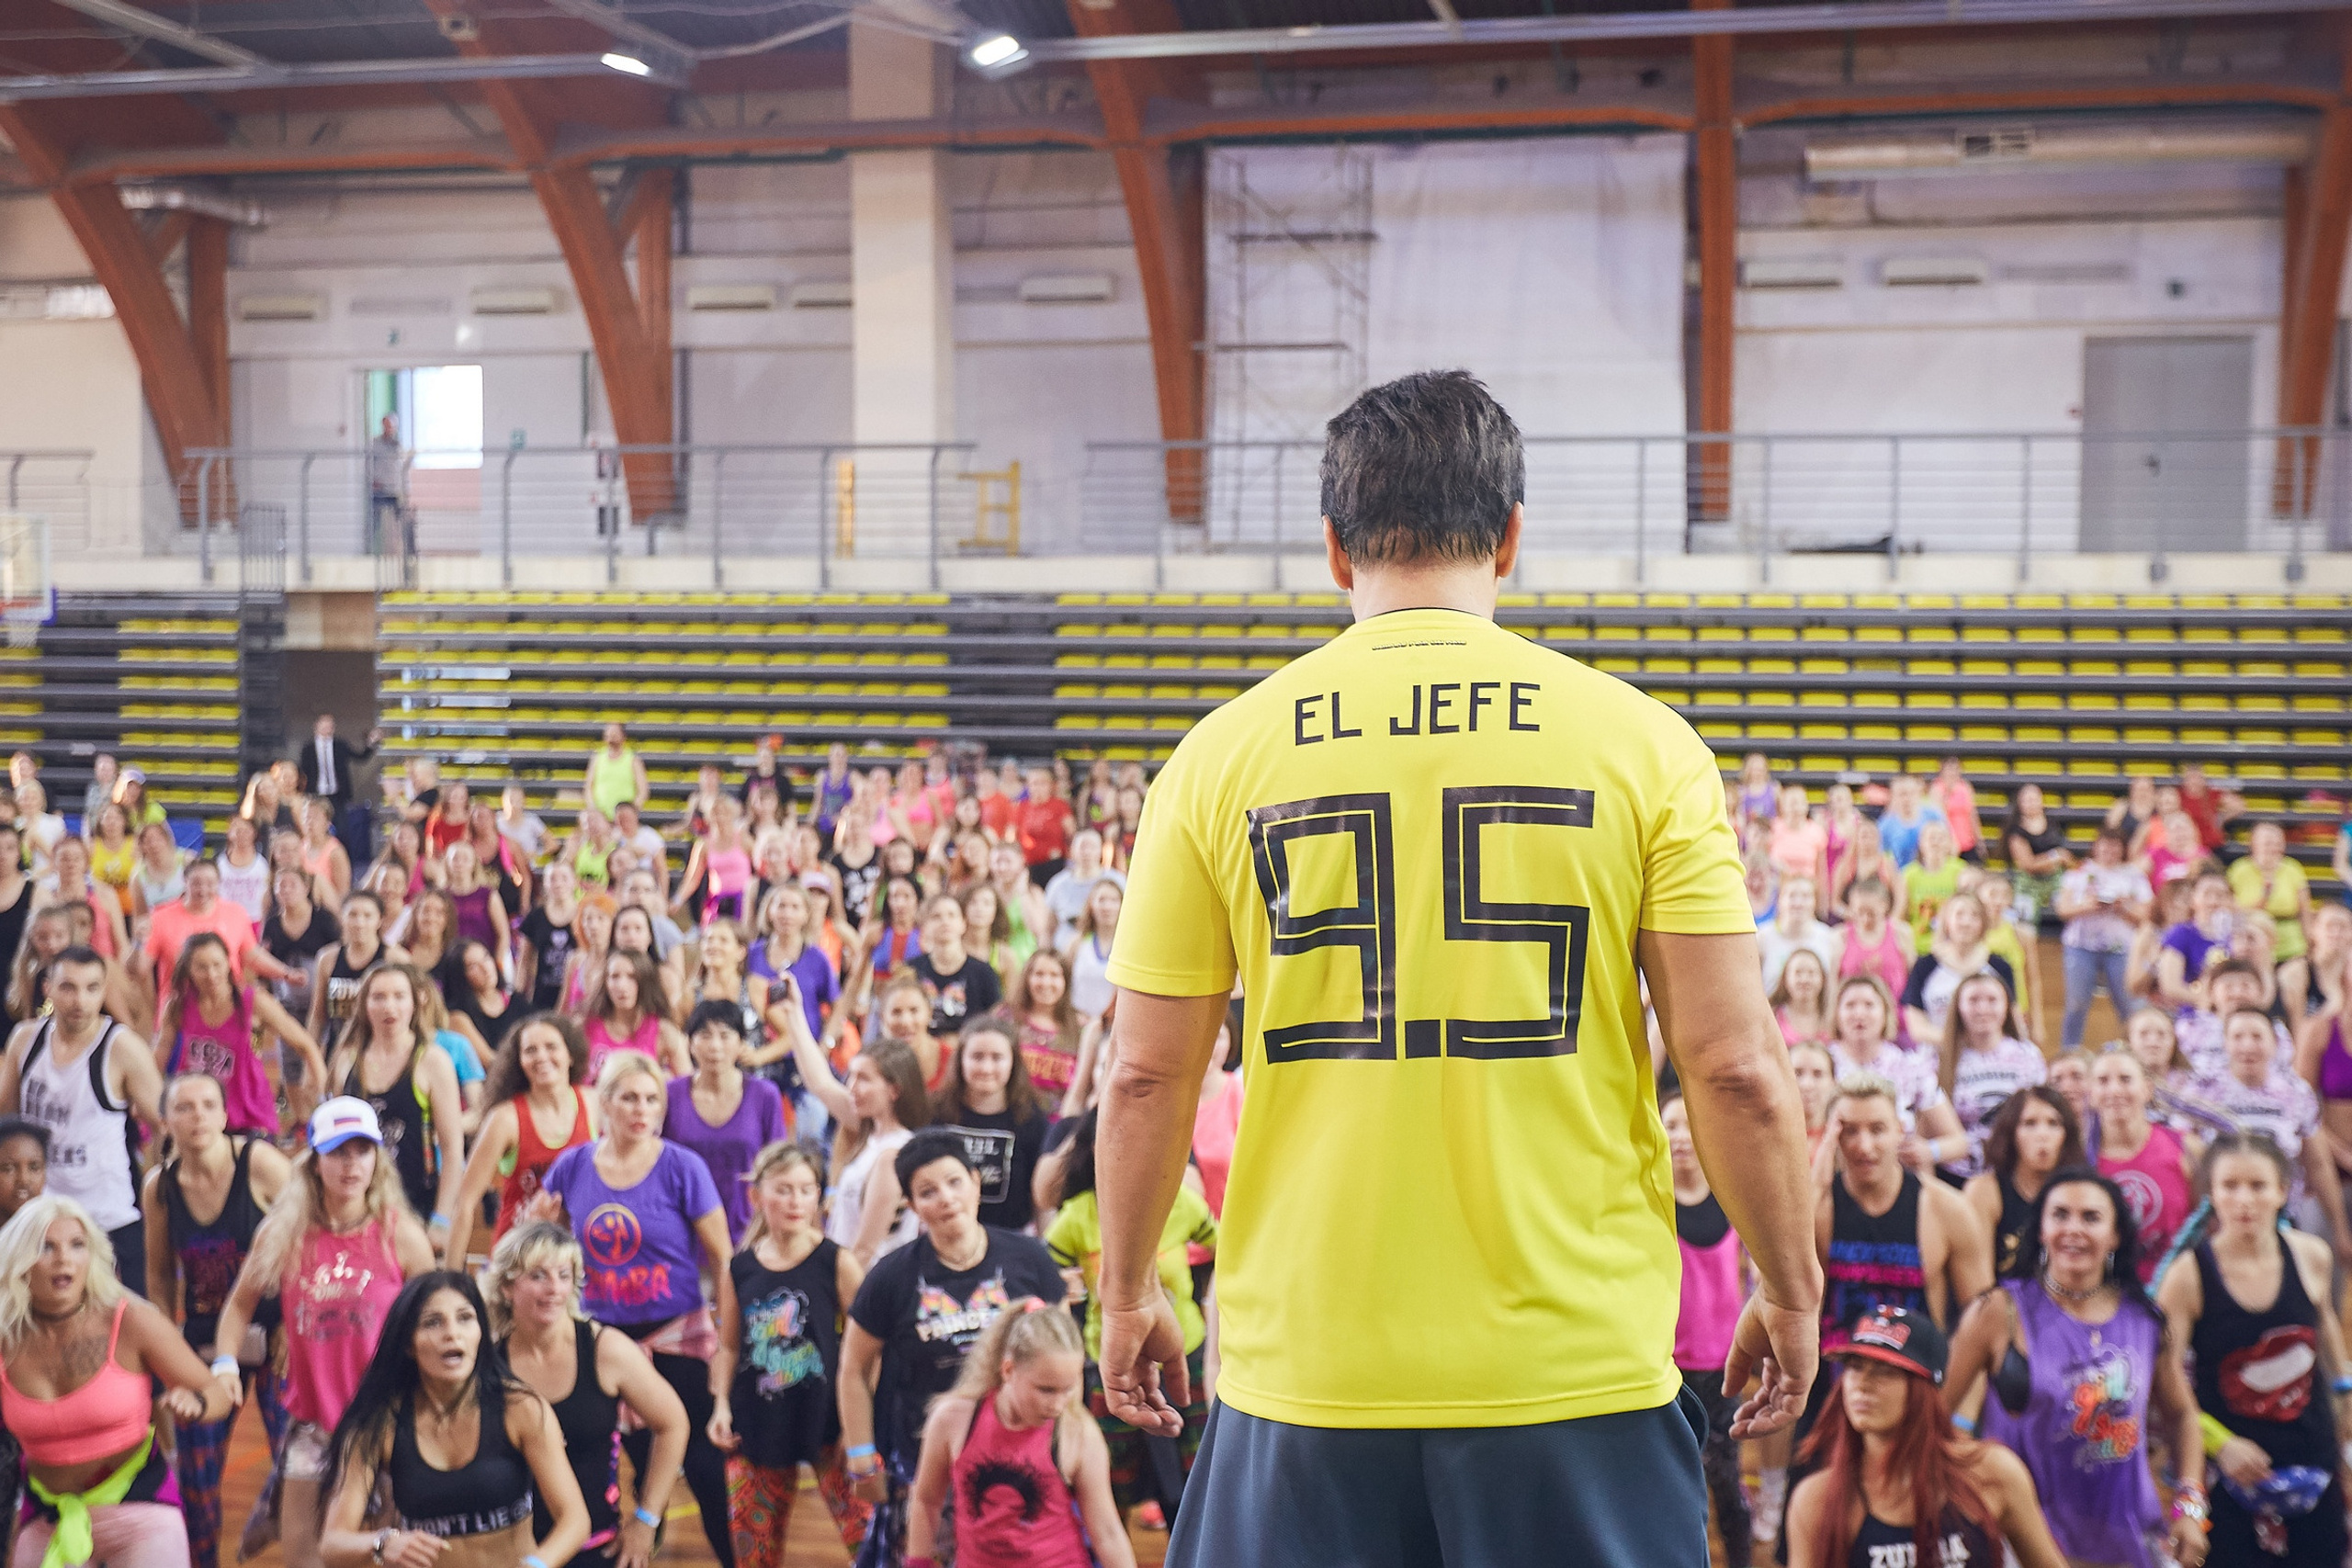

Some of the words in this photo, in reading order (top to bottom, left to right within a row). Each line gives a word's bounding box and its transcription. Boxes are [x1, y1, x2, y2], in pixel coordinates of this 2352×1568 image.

[1295, 692, 1362, 746] EL
[1389, 682, 1541, 736] JEFE
[1245, 785, 1595, 1065] 9.5
[584, 1263, 673, 1306] UMBA
[475, 1506, 511, 1533] LIE
